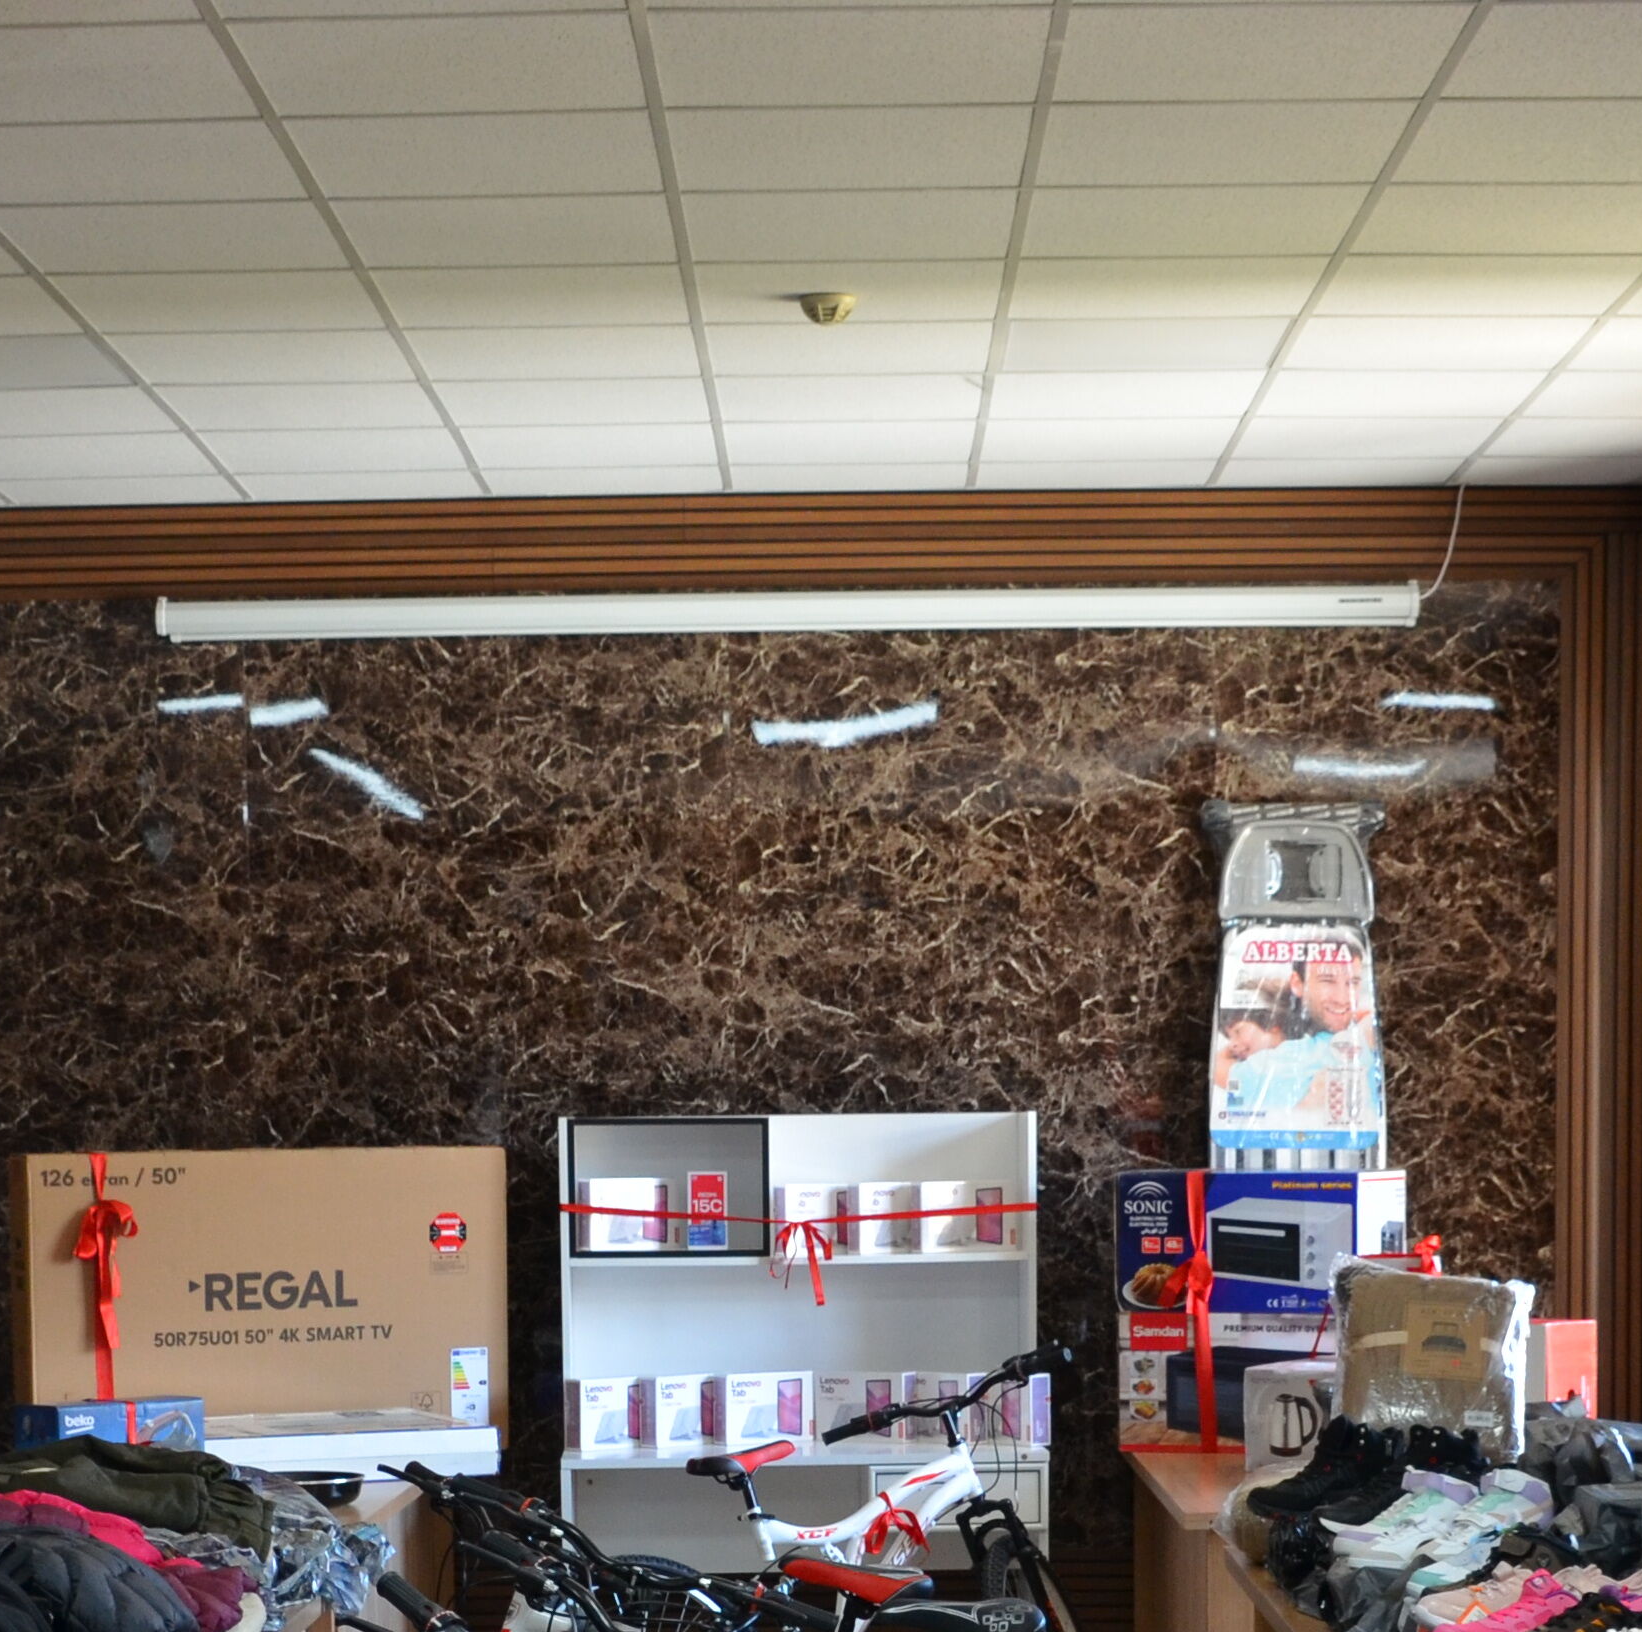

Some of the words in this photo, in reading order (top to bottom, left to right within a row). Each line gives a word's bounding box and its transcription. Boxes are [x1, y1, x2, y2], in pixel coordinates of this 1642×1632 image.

[1243, 941, 1353, 963] ALBERTA
[40, 1169, 74, 1187] 126
[81, 1174, 129, 1187] eran
[152, 1167, 186, 1184] 50"
[1272, 1181, 1318, 1190] Platinum
[1320, 1182, 1352, 1190] series
[692, 1200, 723, 1213] 15C
[1124, 1200, 1172, 1214] SONIC
[204, 1270, 358, 1312] REGAL
[1223, 1325, 1264, 1333] PREMIUM
[1265, 1325, 1302, 1333] QUALITY
[154, 1331, 240, 1347] 50R75U01
[245, 1328, 275, 1345] 50"
[279, 1328, 300, 1343] 4K
[306, 1325, 366, 1342] SMART
[370, 1324, 394, 1340] TV
[731, 1380, 761, 1389] Lenovo
[819, 1376, 850, 1386] Lenovo
[585, 1385, 613, 1394] Lenovo
[660, 1382, 688, 1391] Lenovo
[820, 1385, 836, 1394] Tab
[586, 1394, 599, 1402] Tab
[660, 1391, 674, 1400] Tab
[731, 1389, 747, 1398] Tab
[64, 1415, 95, 1428] beko
[796, 1528, 838, 1540] XCF
